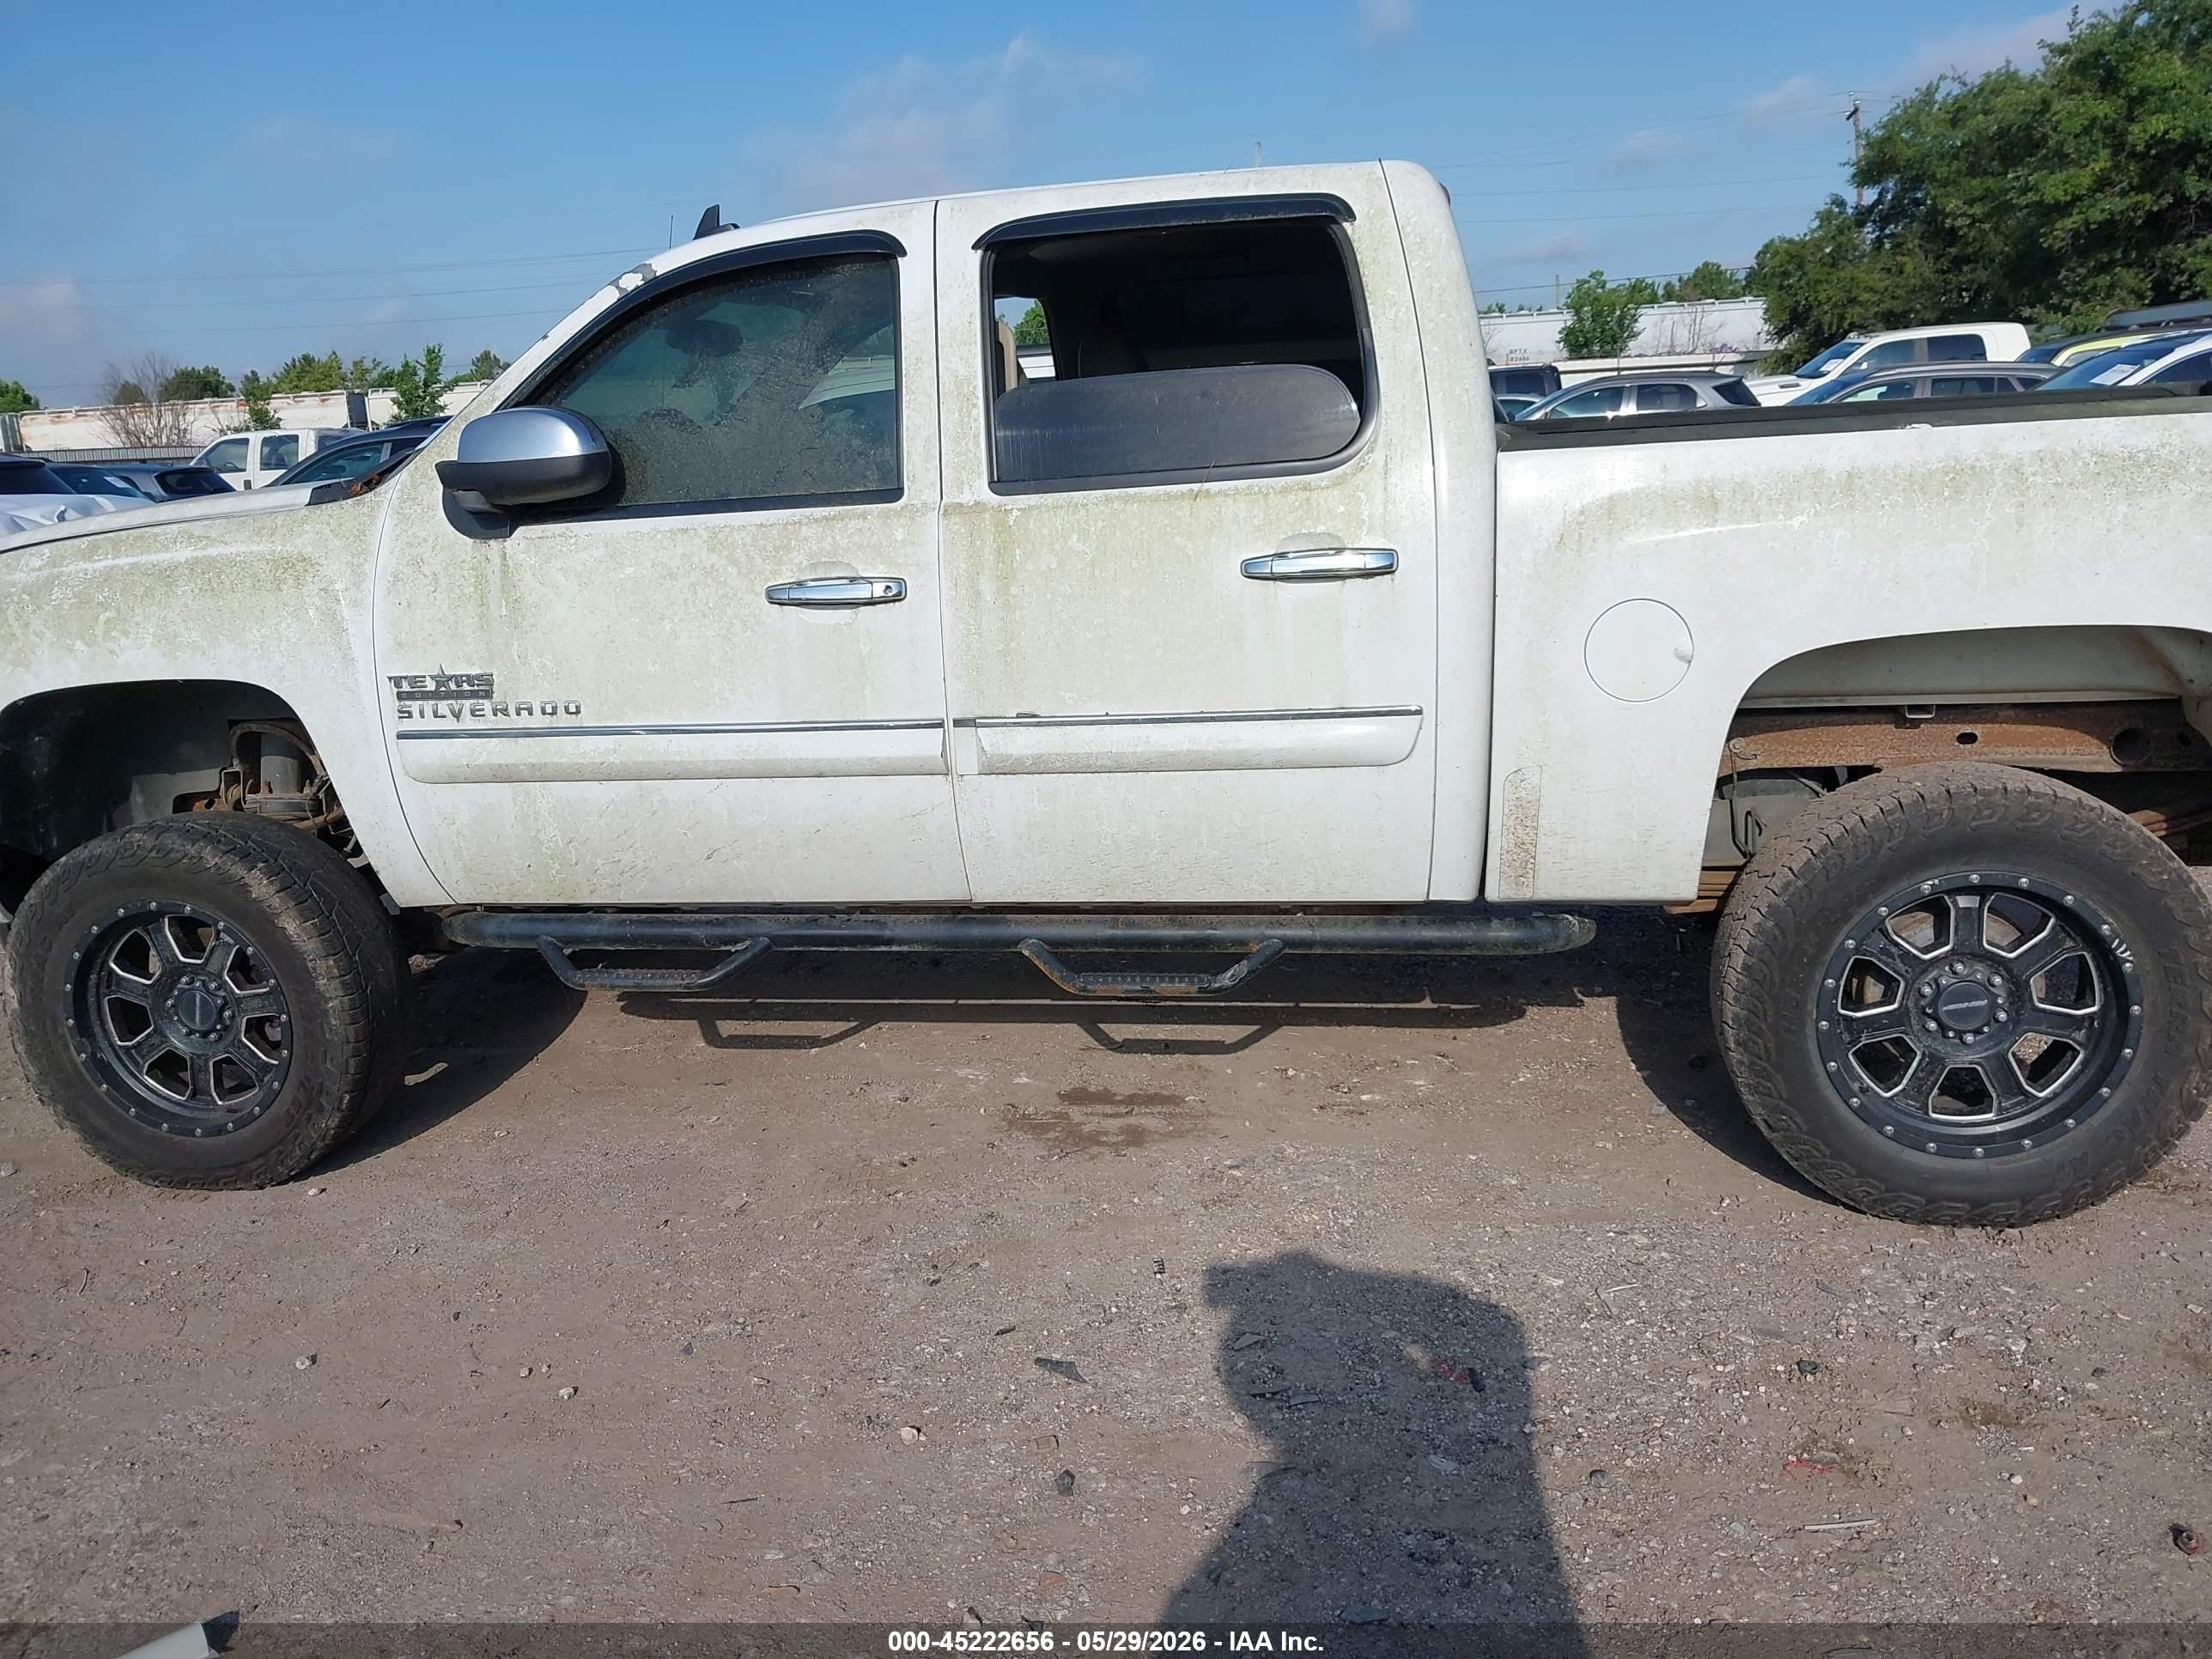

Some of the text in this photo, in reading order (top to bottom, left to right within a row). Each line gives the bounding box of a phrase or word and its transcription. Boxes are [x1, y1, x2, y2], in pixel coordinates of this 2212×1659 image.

[386, 666, 495, 690] TEXAS
[400, 690, 486, 699] EDITION
[397, 700, 582, 719] SILVERADO
